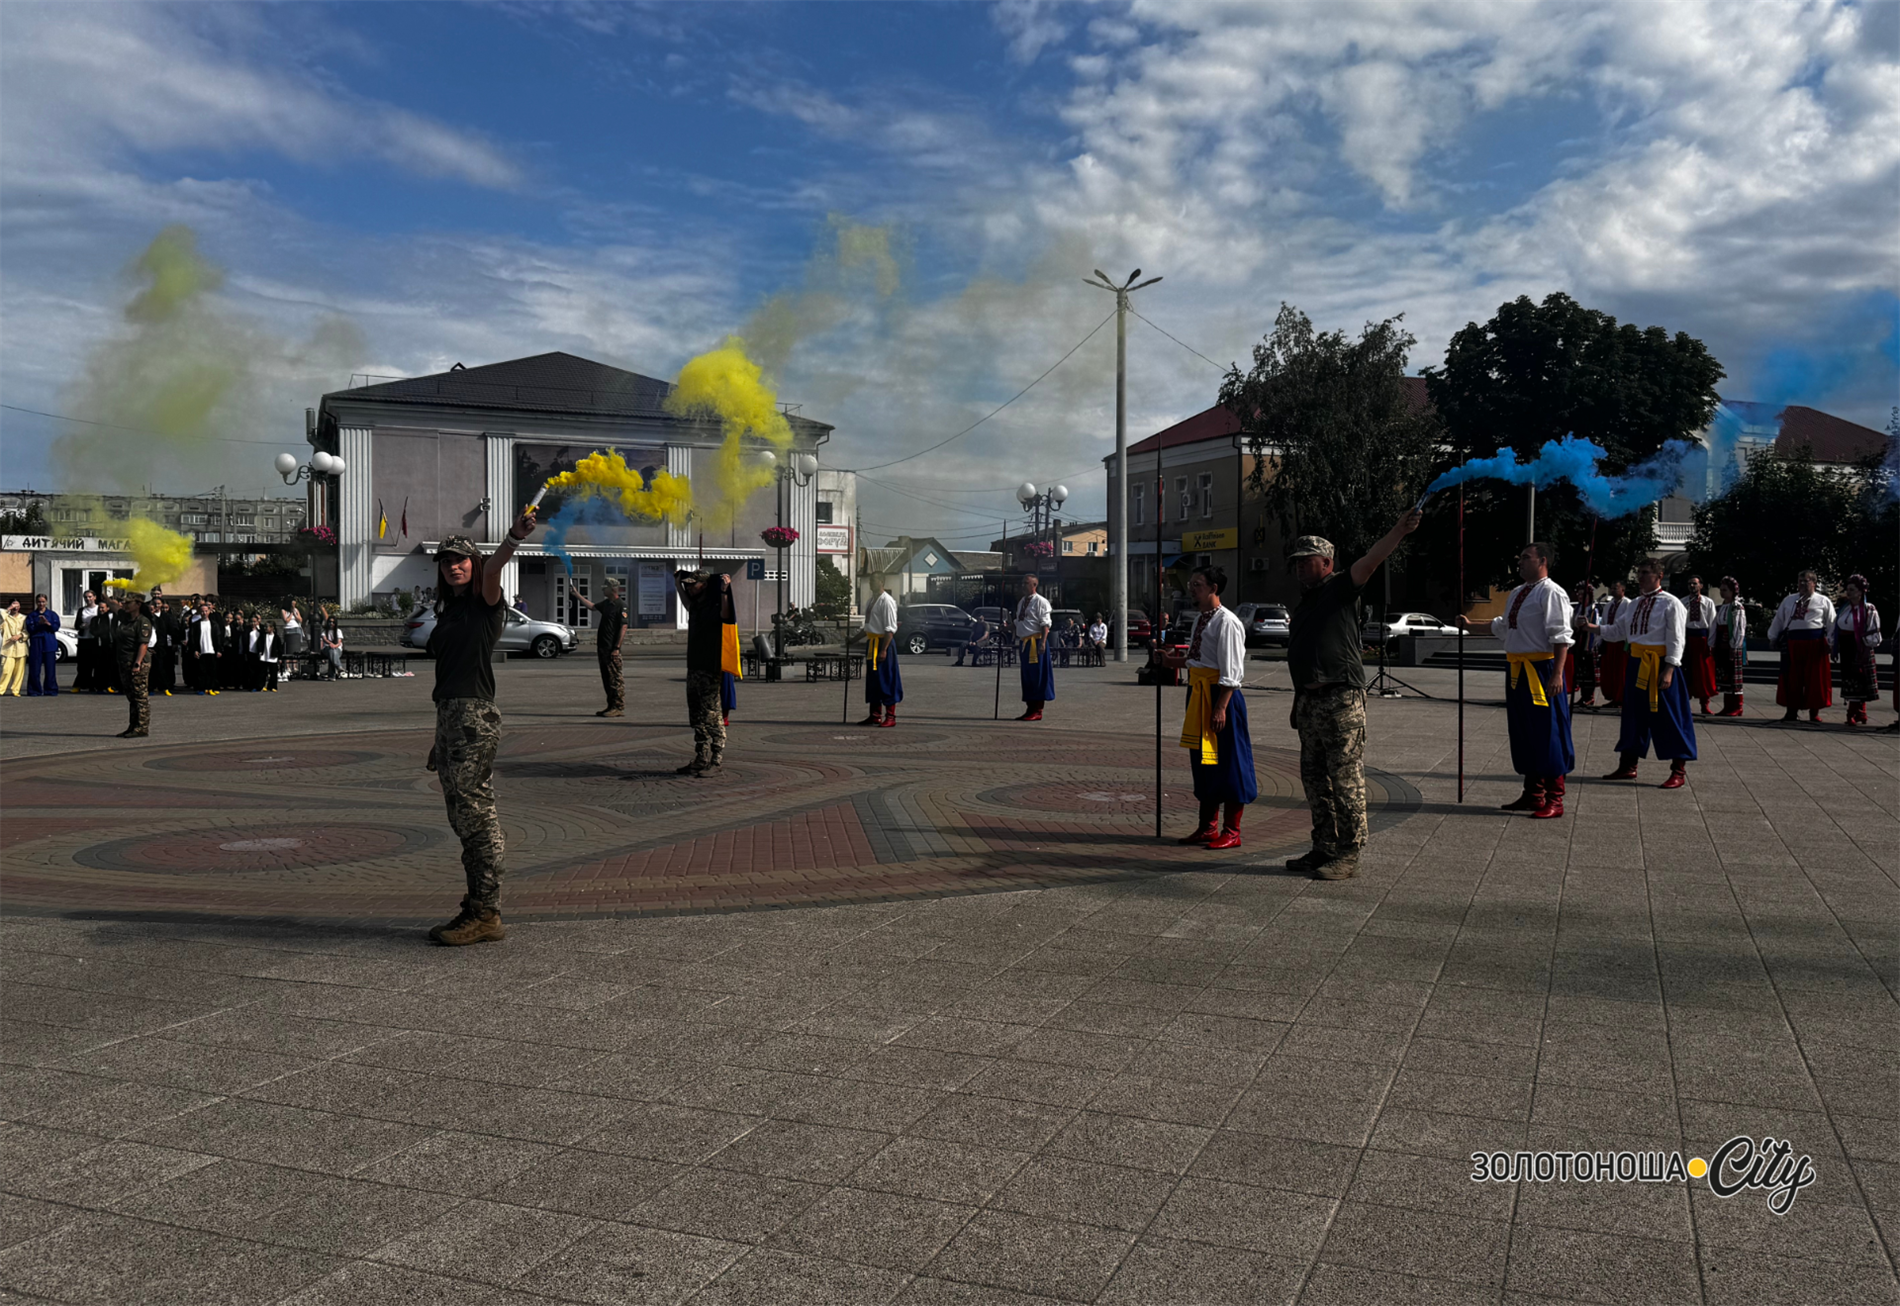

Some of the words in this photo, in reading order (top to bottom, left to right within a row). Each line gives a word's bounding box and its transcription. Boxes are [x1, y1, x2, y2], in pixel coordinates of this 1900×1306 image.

[22, 537, 85, 550] ДИТЯЧИЙ
[97, 539, 132, 550] МАГА
[751, 562, 761, 576] P
